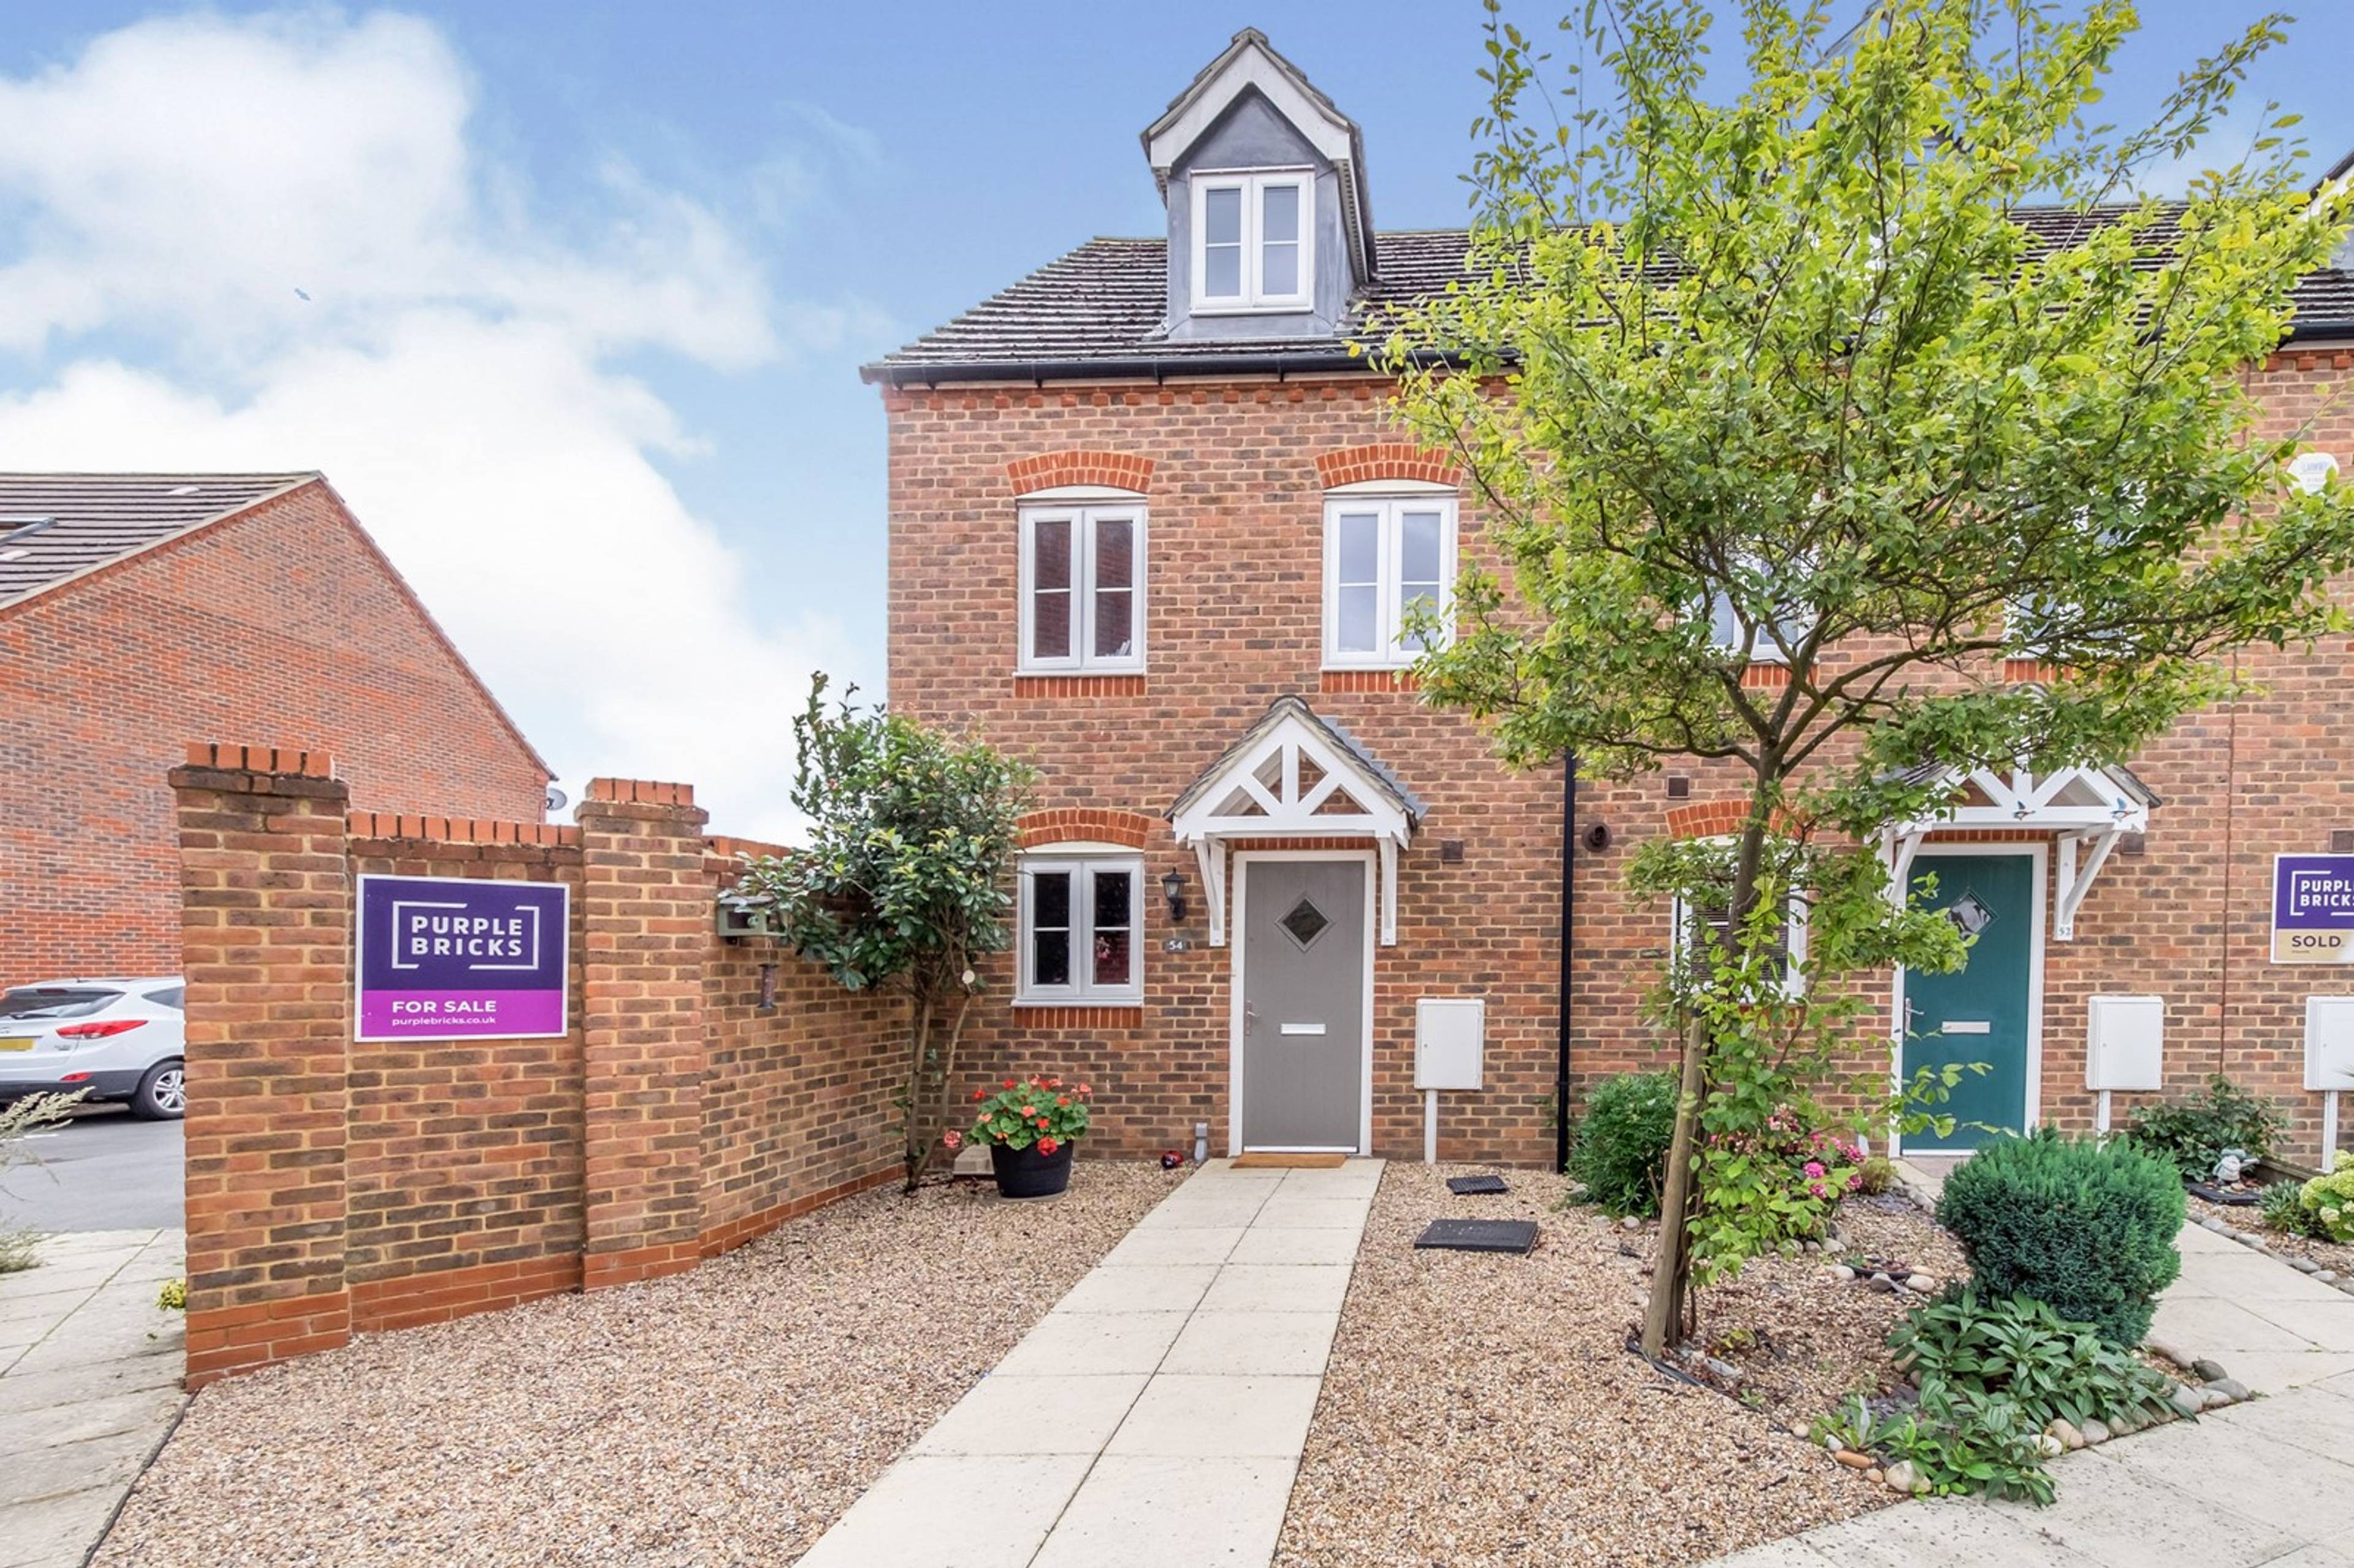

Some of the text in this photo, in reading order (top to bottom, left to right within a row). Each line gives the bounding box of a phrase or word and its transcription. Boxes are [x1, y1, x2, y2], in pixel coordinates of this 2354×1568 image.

[2301, 880, 2354, 892] PURPL
[411, 916, 522, 935] PURPLE
[2059, 927, 2071, 935] 52
[411, 937, 522, 956] BRICKS
[1169, 940, 1183, 950] 54
[2292, 935, 2341, 947] SOLD
[392, 1000, 497, 1013] FOR SALE
[392, 1016, 495, 1026] purplebricks.co.uk
